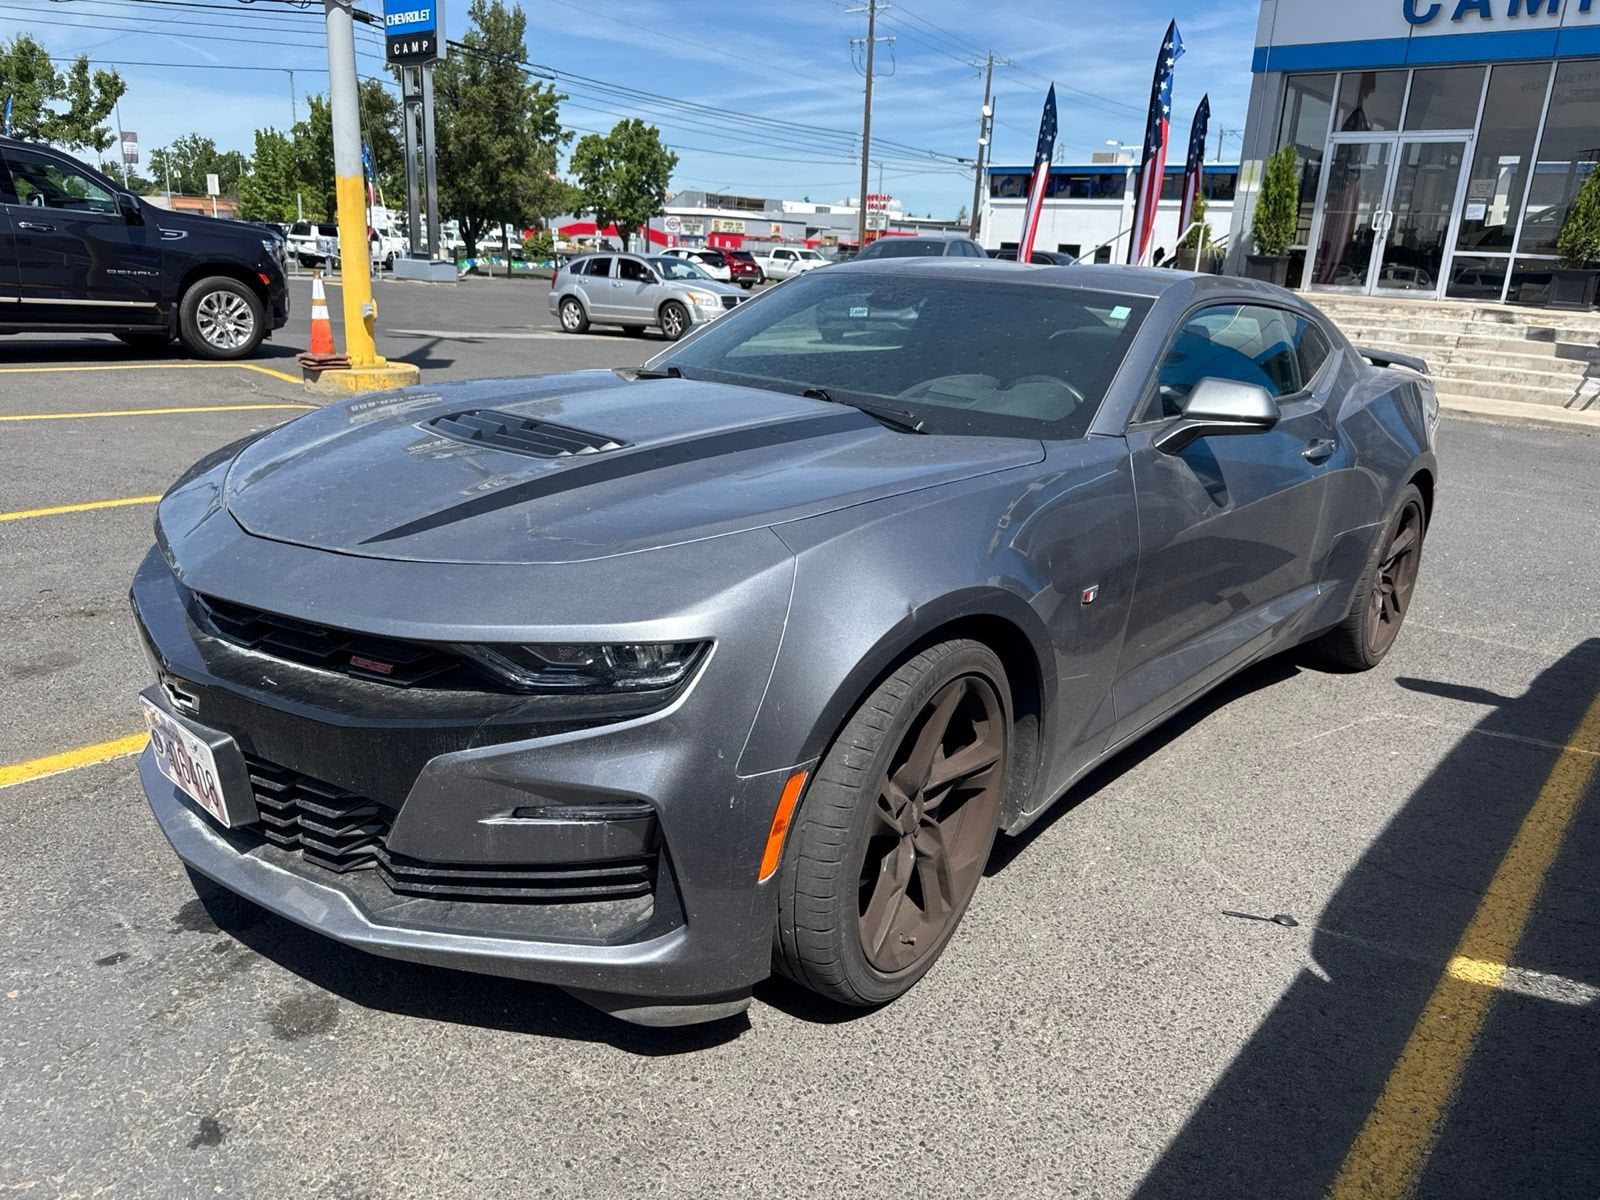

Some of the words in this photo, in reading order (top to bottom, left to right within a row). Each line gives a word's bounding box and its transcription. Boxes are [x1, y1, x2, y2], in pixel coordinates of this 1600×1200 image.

[386, 9, 431, 26] CHEVROLET
[393, 40, 429, 55] CAMP
[167, 740, 219, 808] 06408
